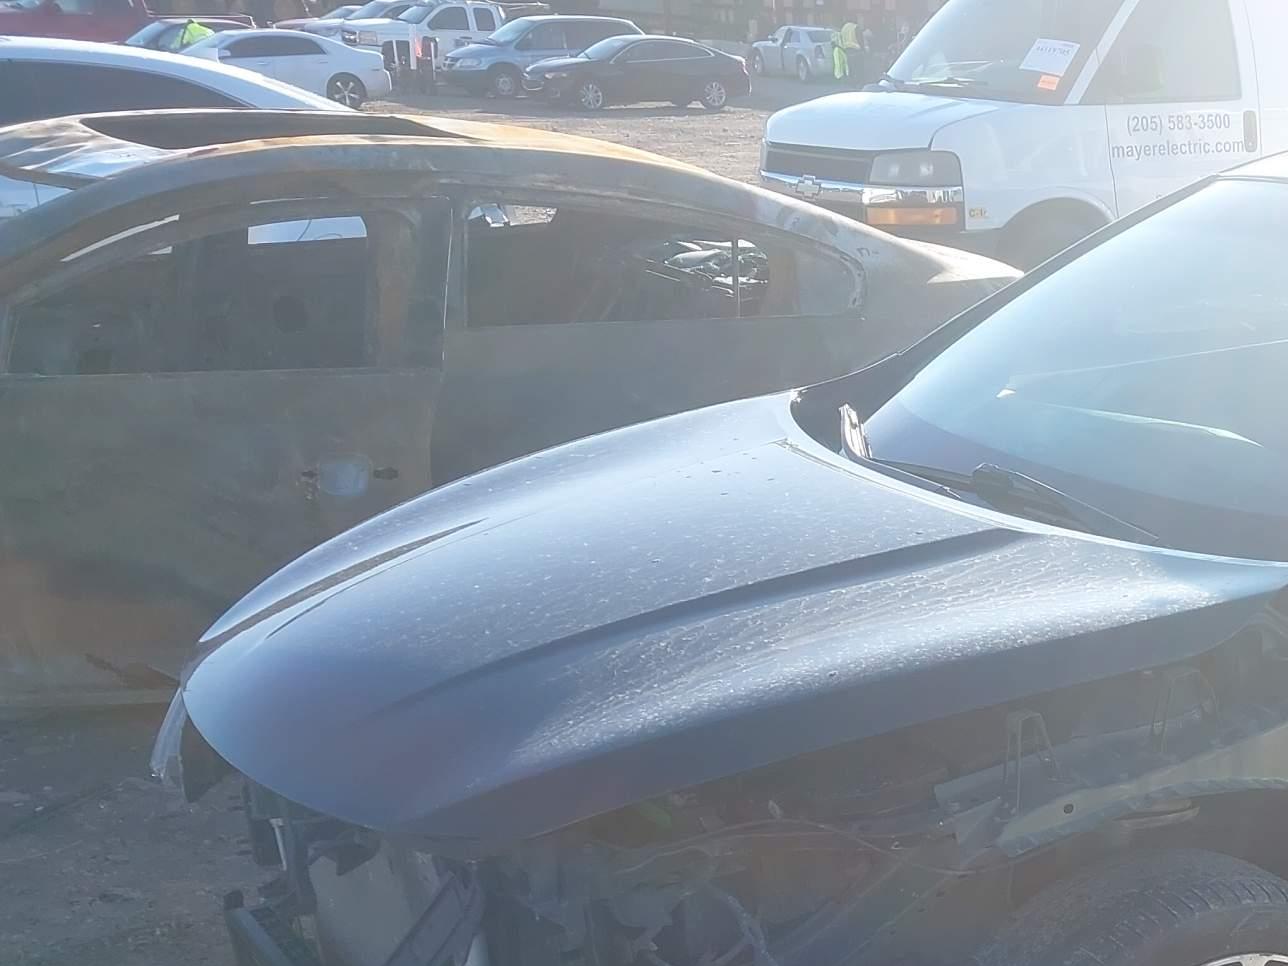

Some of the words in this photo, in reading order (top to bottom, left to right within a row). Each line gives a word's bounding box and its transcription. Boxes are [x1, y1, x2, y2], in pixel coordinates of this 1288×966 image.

[1127, 114, 1163, 136] (205)
[1168, 112, 1231, 130] 583-3500
[1111, 138, 1245, 161] mayerelectric.com
